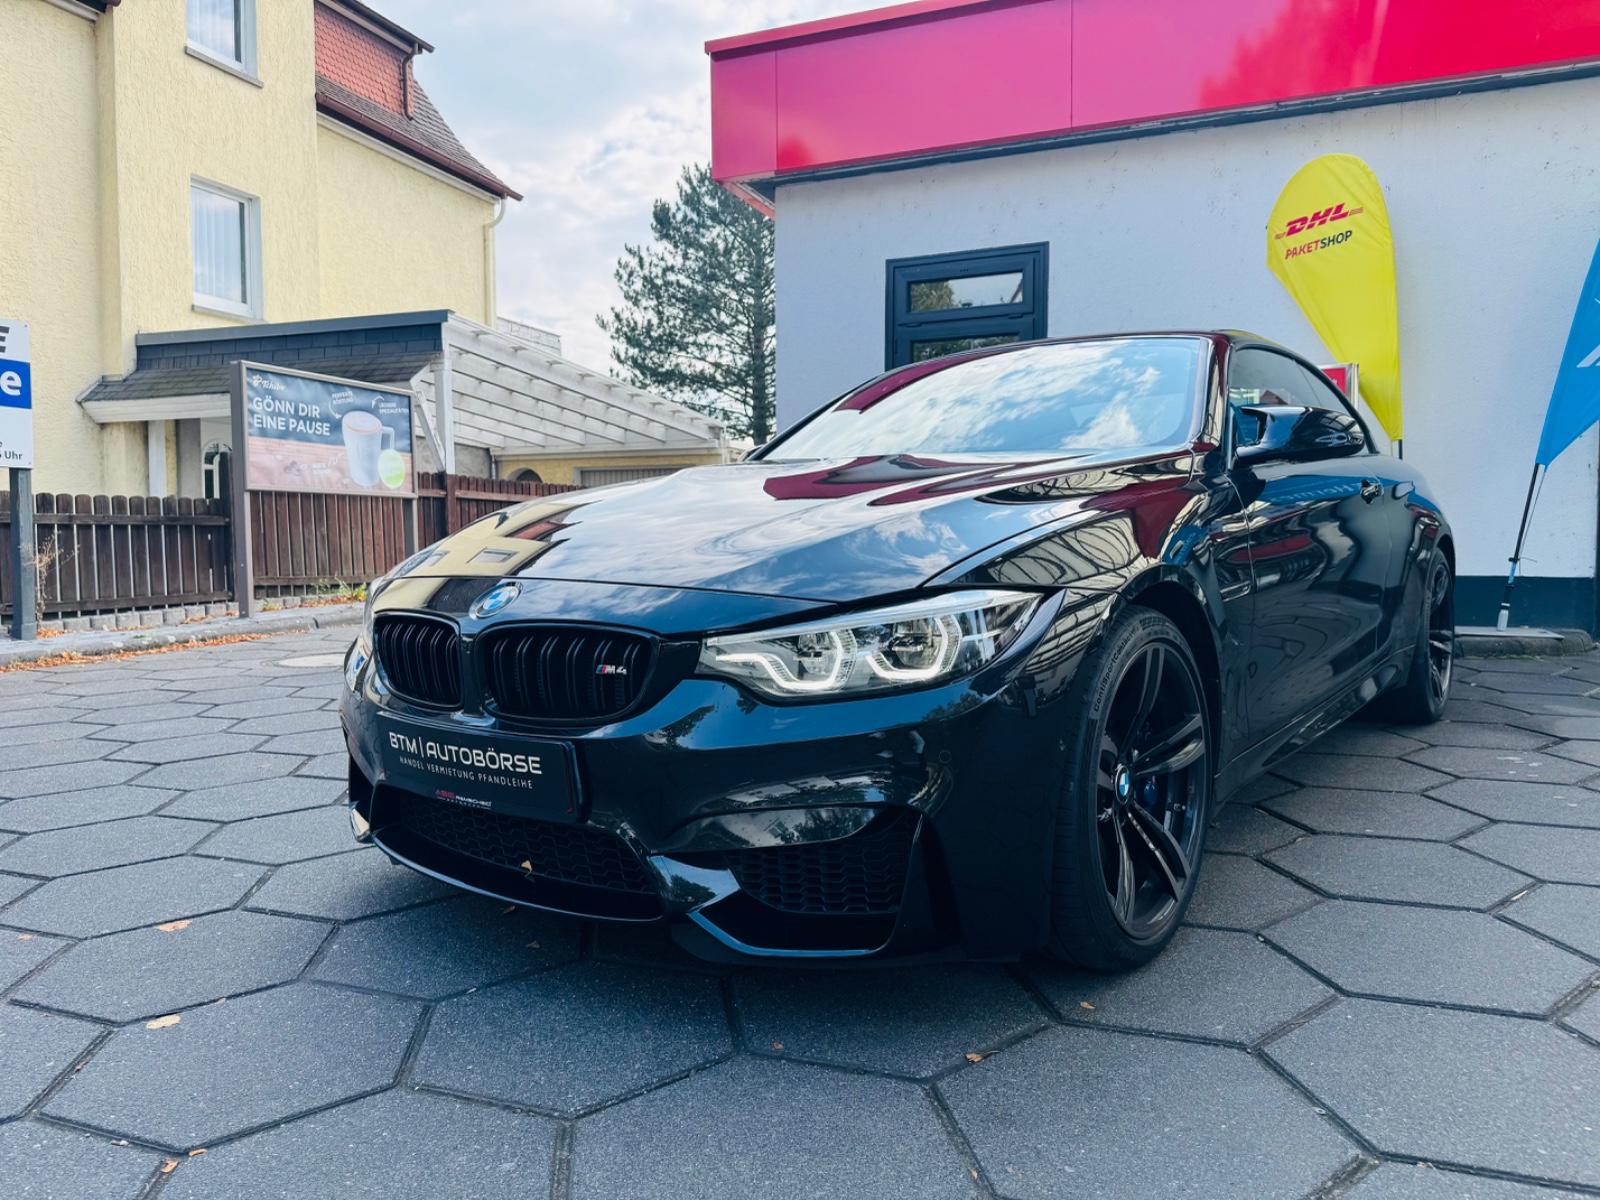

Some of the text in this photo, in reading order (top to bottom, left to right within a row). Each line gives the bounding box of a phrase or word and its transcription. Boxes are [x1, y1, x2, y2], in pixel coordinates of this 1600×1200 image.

[1286, 203, 1349, 236] DHL
[1285, 230, 1353, 260] PAKETSHOP
[253, 395, 320, 418] GÖNN DIR
[254, 414, 331, 436] EINE PAUSE
[4, 450, 22, 459] Uhr
[601, 664, 628, 675] M4
[389, 732, 542, 774] BTM AUTOBÖRSE
[400, 756, 533, 789] HANDEL VERMIETUNG PFANDLEIHE
